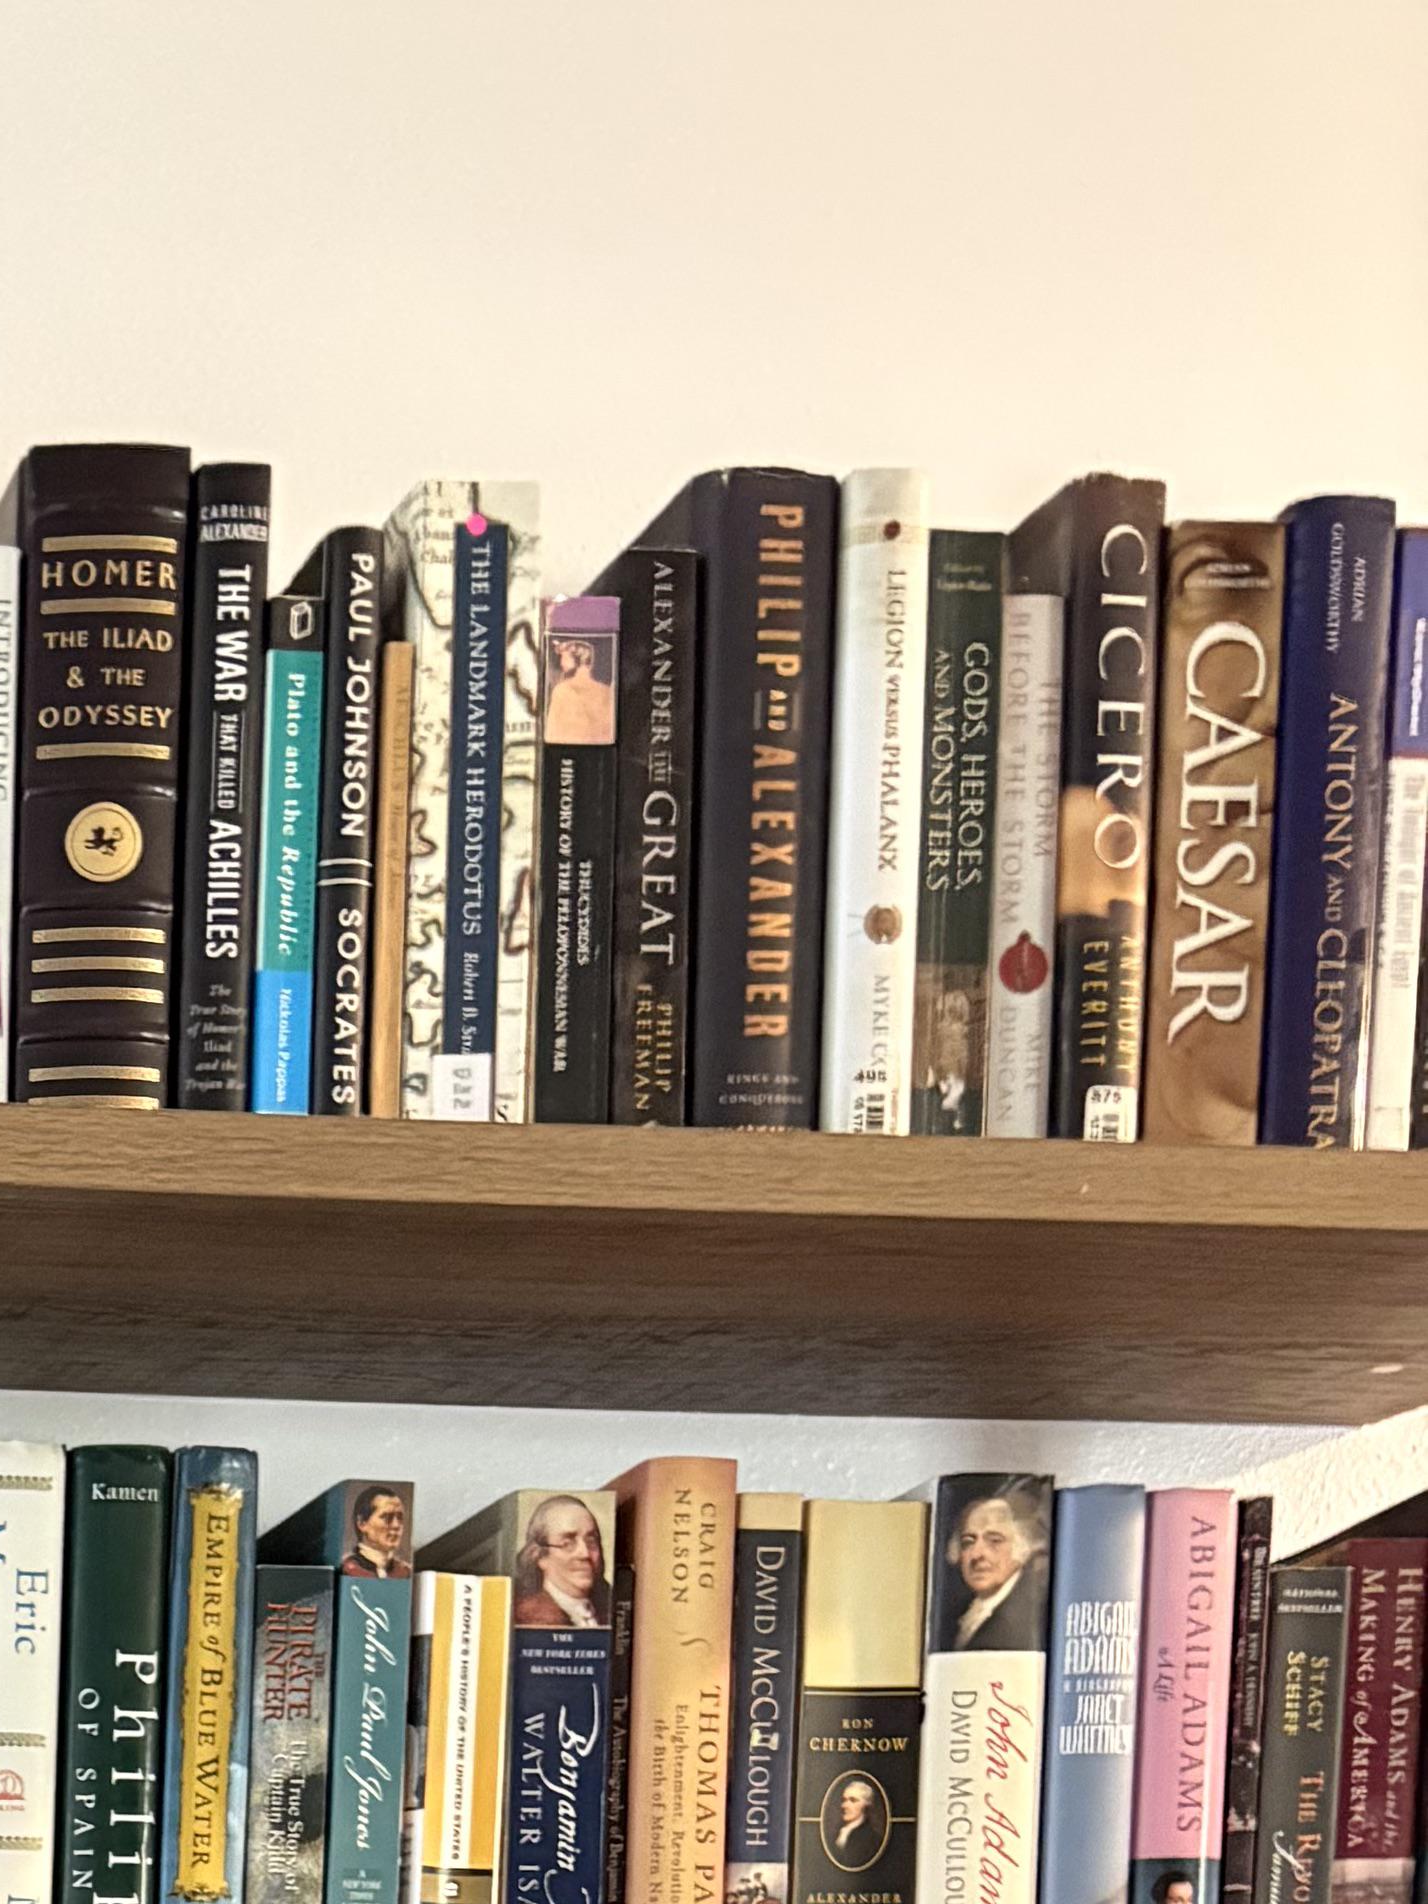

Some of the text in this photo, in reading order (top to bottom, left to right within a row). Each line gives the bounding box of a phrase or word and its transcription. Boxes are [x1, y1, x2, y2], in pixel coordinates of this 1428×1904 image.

[40, 561, 177, 590] HOMER
[43, 627, 173, 652] THE ILIAD
[66, 666, 144, 688] & THE
[1093, 525, 1147, 869] CICERO
[38, 706, 172, 730] ODYSSEY
[1167, 620, 1268, 1045] CAESAR
[332, 908, 362, 1106] SOCRATES
[91, 1483, 158, 1502] Kamen
[15, 1568, 49, 1654] Eric
[1176, 1515, 1216, 1834] ABIGAIL ADAMS
[841, 1718, 873, 1730] RON
[809, 1735, 908, 1753] CHERNOW
[806, 1892, 903, 1904] ALEXANDER
